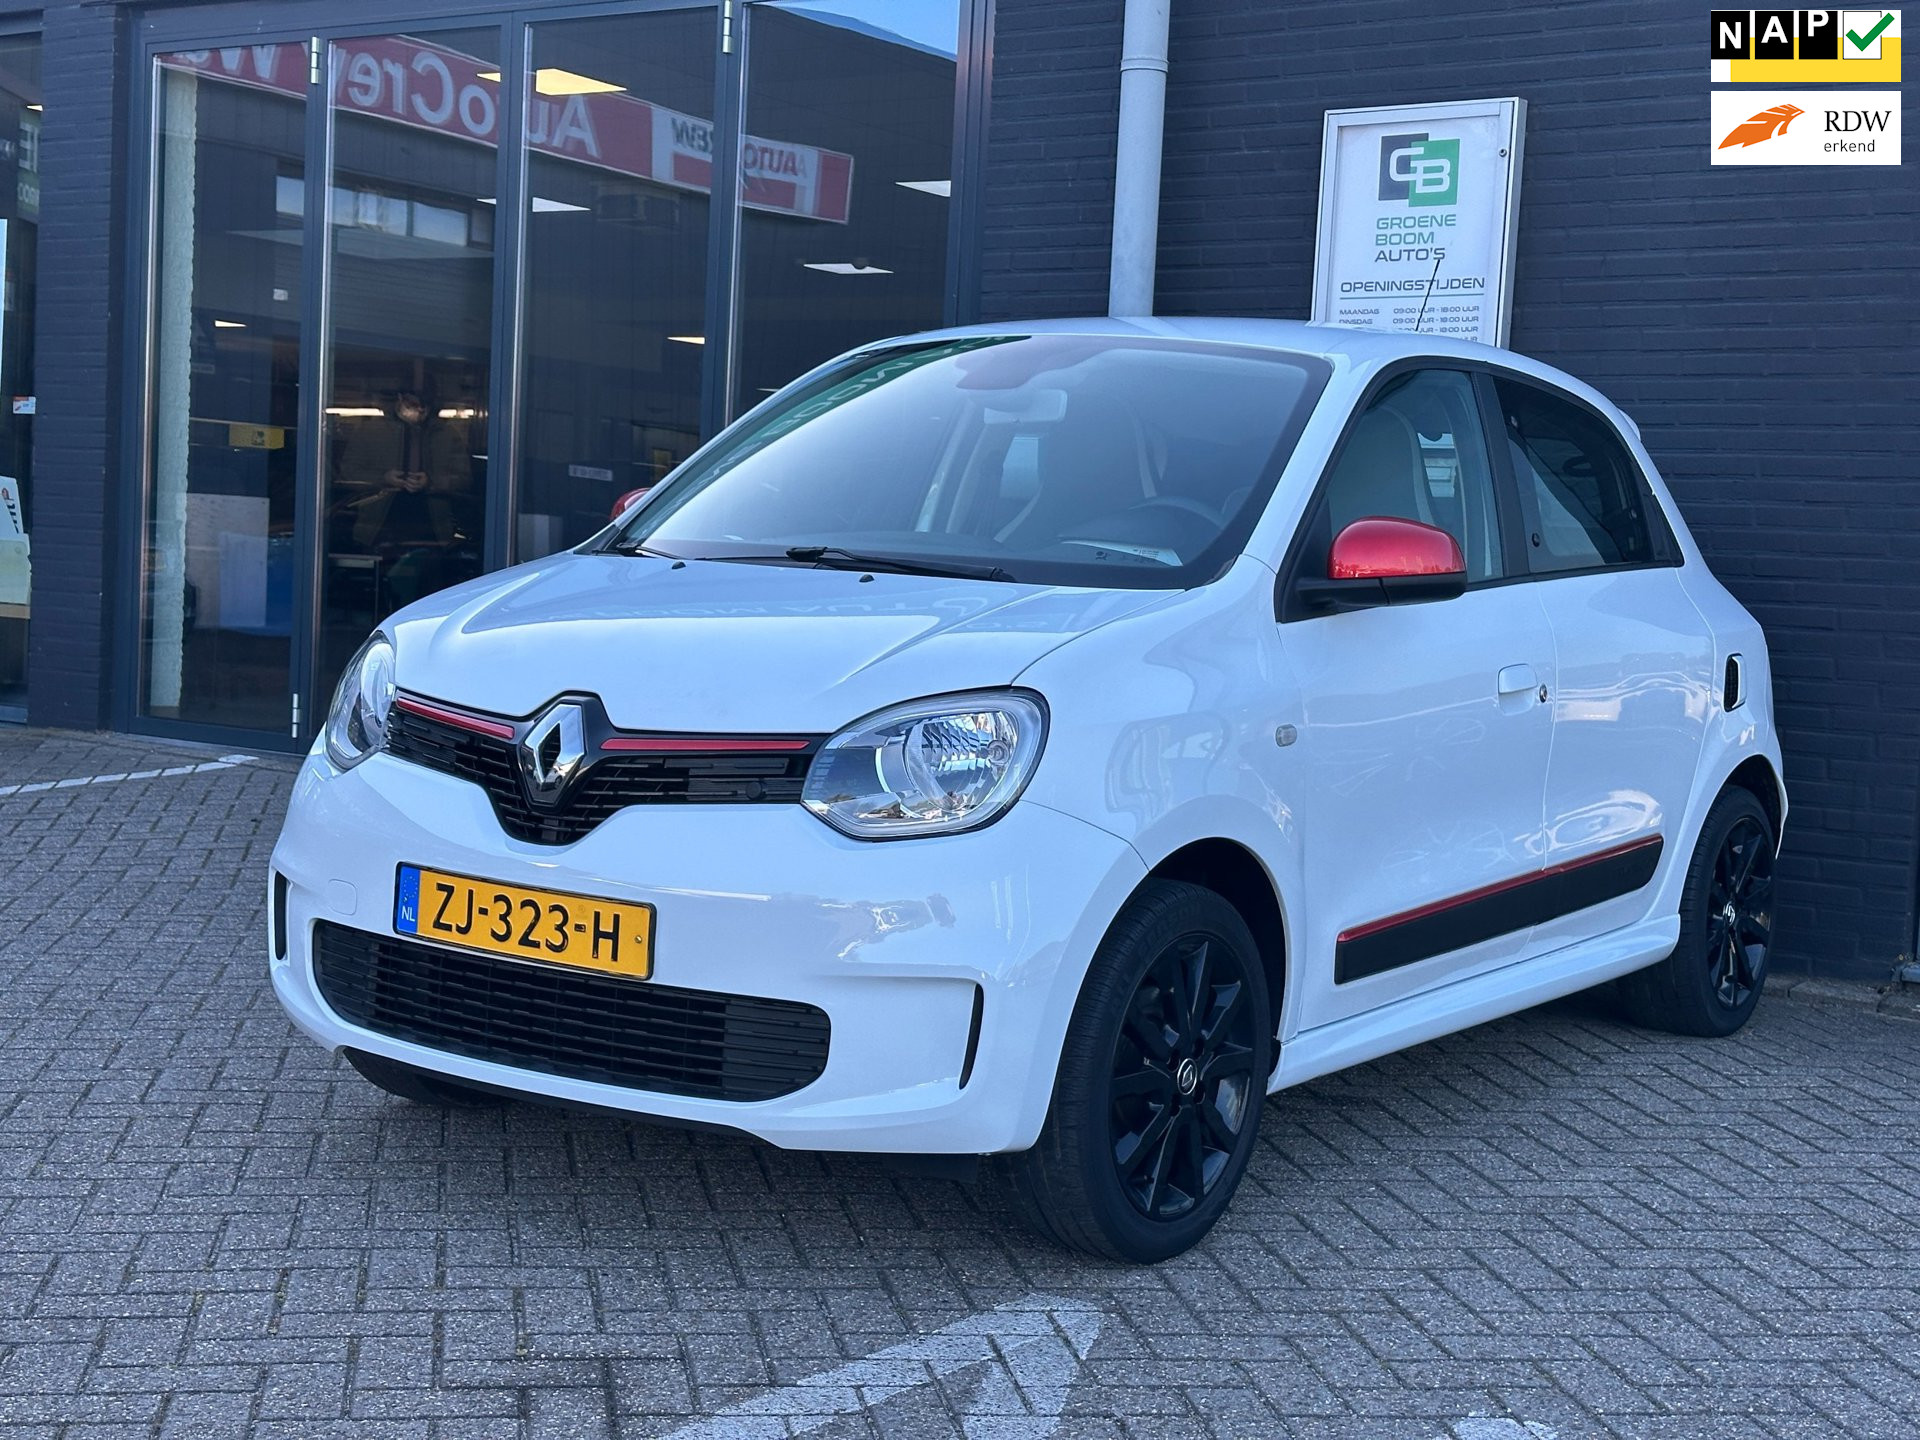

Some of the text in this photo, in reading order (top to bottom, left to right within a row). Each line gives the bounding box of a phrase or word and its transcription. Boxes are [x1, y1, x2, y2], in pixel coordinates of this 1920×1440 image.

[1376, 214, 1457, 230] GROENE
[1375, 231, 1435, 246] BOOM
[1374, 247, 1446, 263] AUTO'S
[1340, 277, 1485, 293] OPENINGSTIJDEN
[401, 882, 622, 962] NL ZJ-323-H
